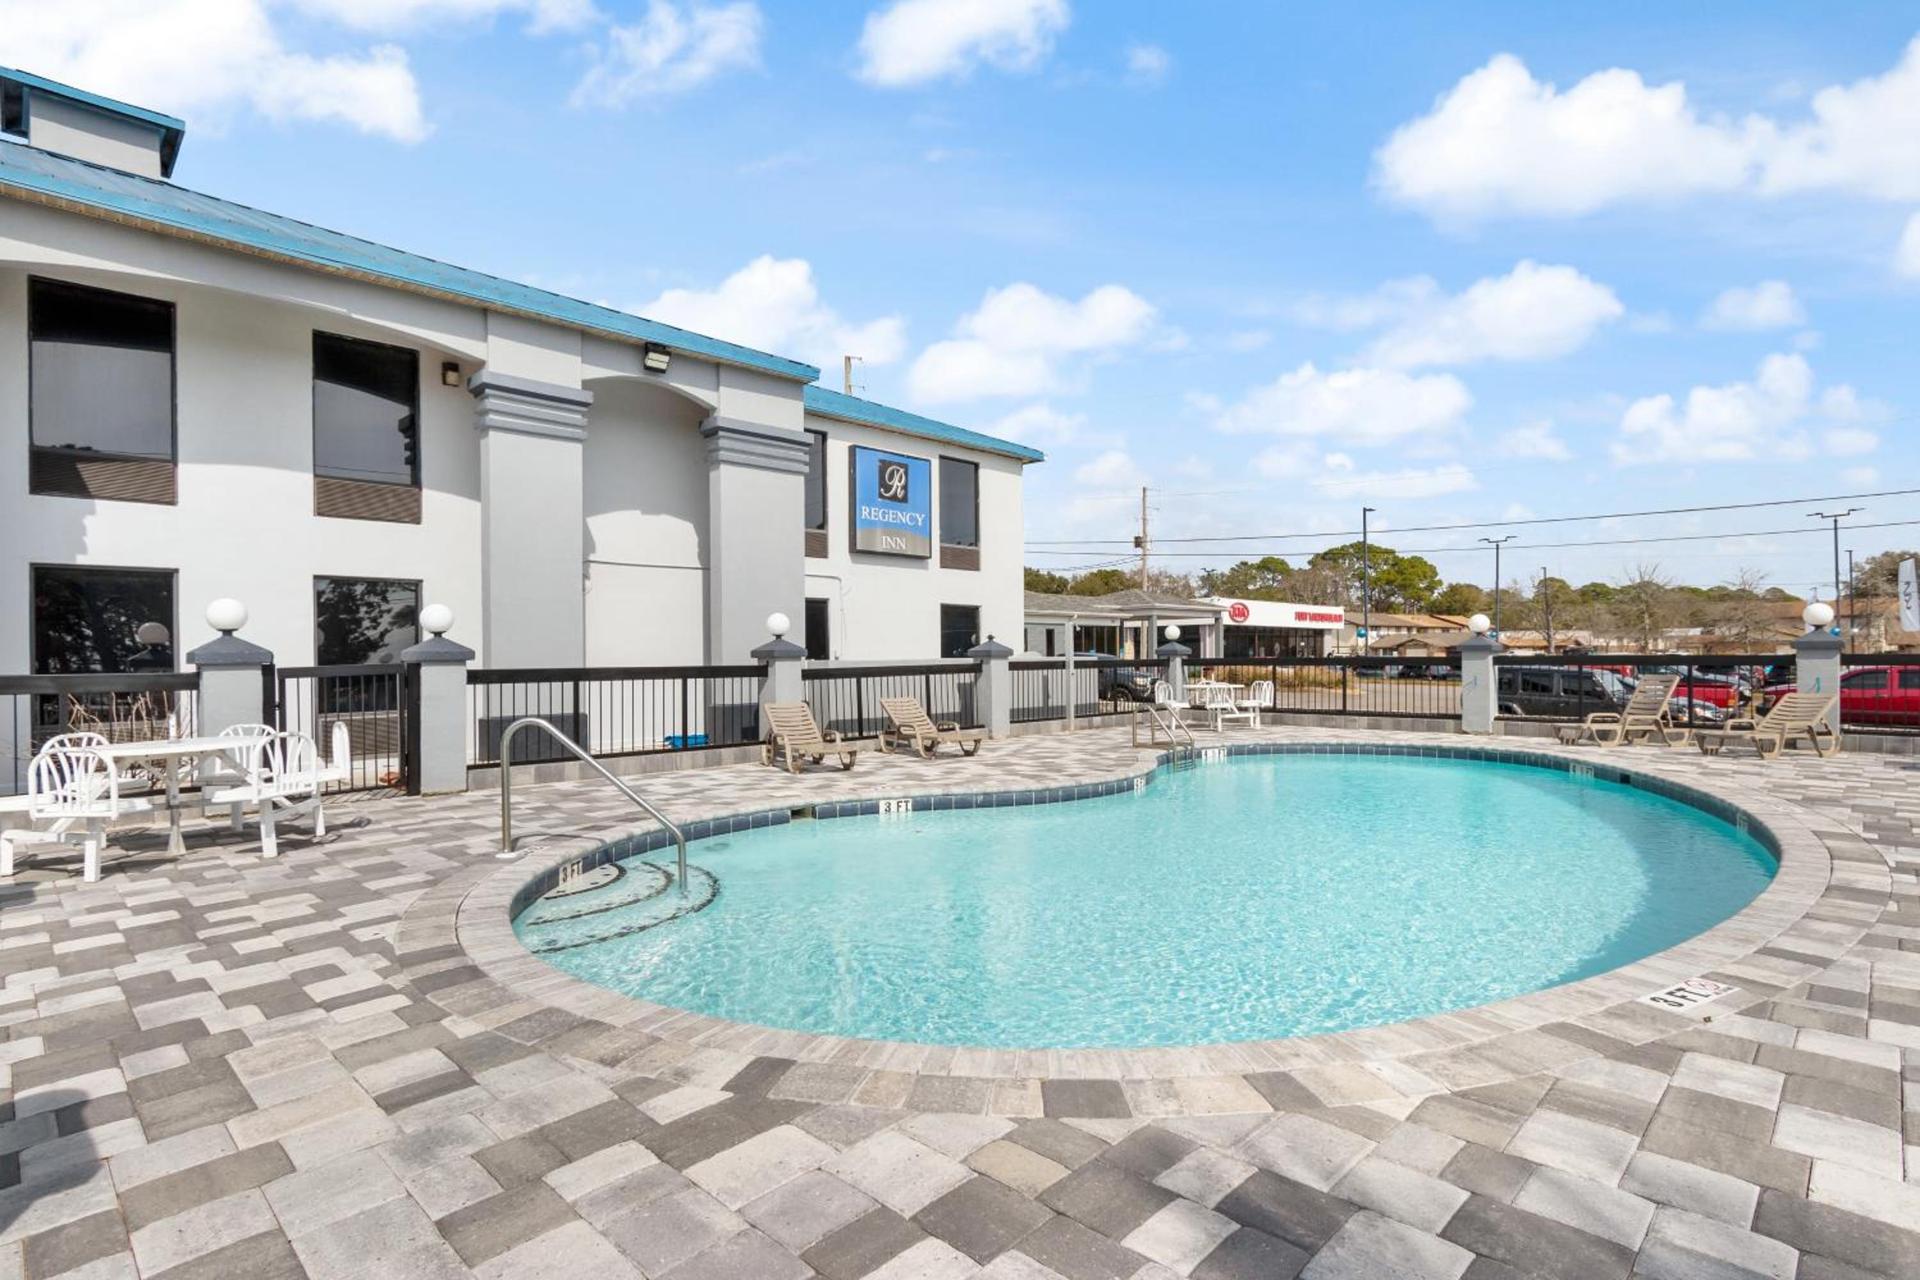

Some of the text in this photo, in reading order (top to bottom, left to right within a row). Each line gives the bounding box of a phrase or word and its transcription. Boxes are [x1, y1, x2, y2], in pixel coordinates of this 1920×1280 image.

[880, 465, 905, 498] R
[861, 506, 925, 526] REGENCY
[882, 536, 906, 550] INN
[884, 801, 892, 813] 3
[562, 866, 568, 883] 3
[1650, 996, 1685, 1008] 3
[1664, 987, 1711, 1003] FT
